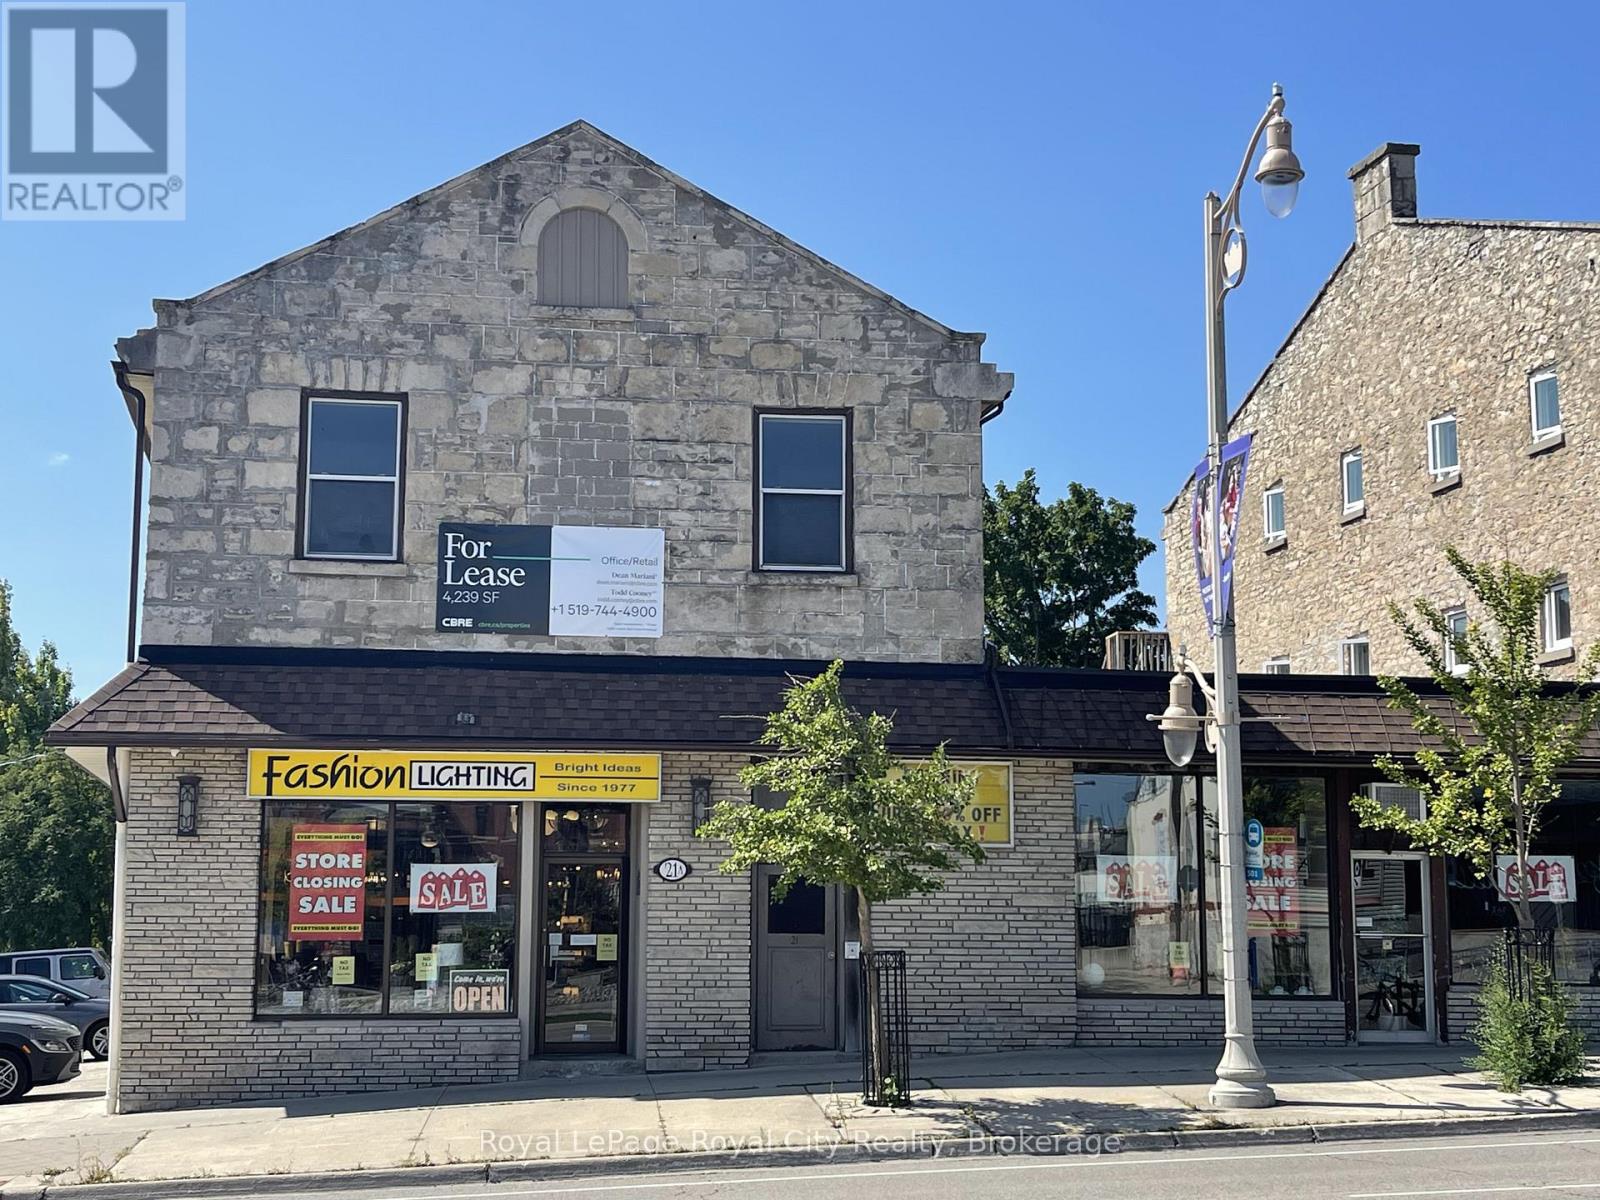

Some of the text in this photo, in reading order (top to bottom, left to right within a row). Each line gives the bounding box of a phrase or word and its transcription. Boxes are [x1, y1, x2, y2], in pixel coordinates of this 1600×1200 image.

[443, 532, 493, 559] For
[601, 556, 659, 567] Office/Retail
[443, 559, 526, 587] Lease
[442, 590, 500, 604] 4,239 SF
[567, 603, 658, 618] 519-744-4900
[442, 617, 474, 628] CBRE
[262, 753, 528, 796] Fashion LIGHTING
[554, 762, 642, 774] Bright Ideas
[557, 782, 637, 793] Since 1977
[971, 807, 1001, 822] OFF
[295, 853, 363, 869] STORE
[293, 876, 363, 889] CLOSING
[420, 879, 487, 906] SALE
[299, 896, 356, 914] SALE
[454, 974, 474, 983] Come
[453, 985, 505, 1012] OPEN
